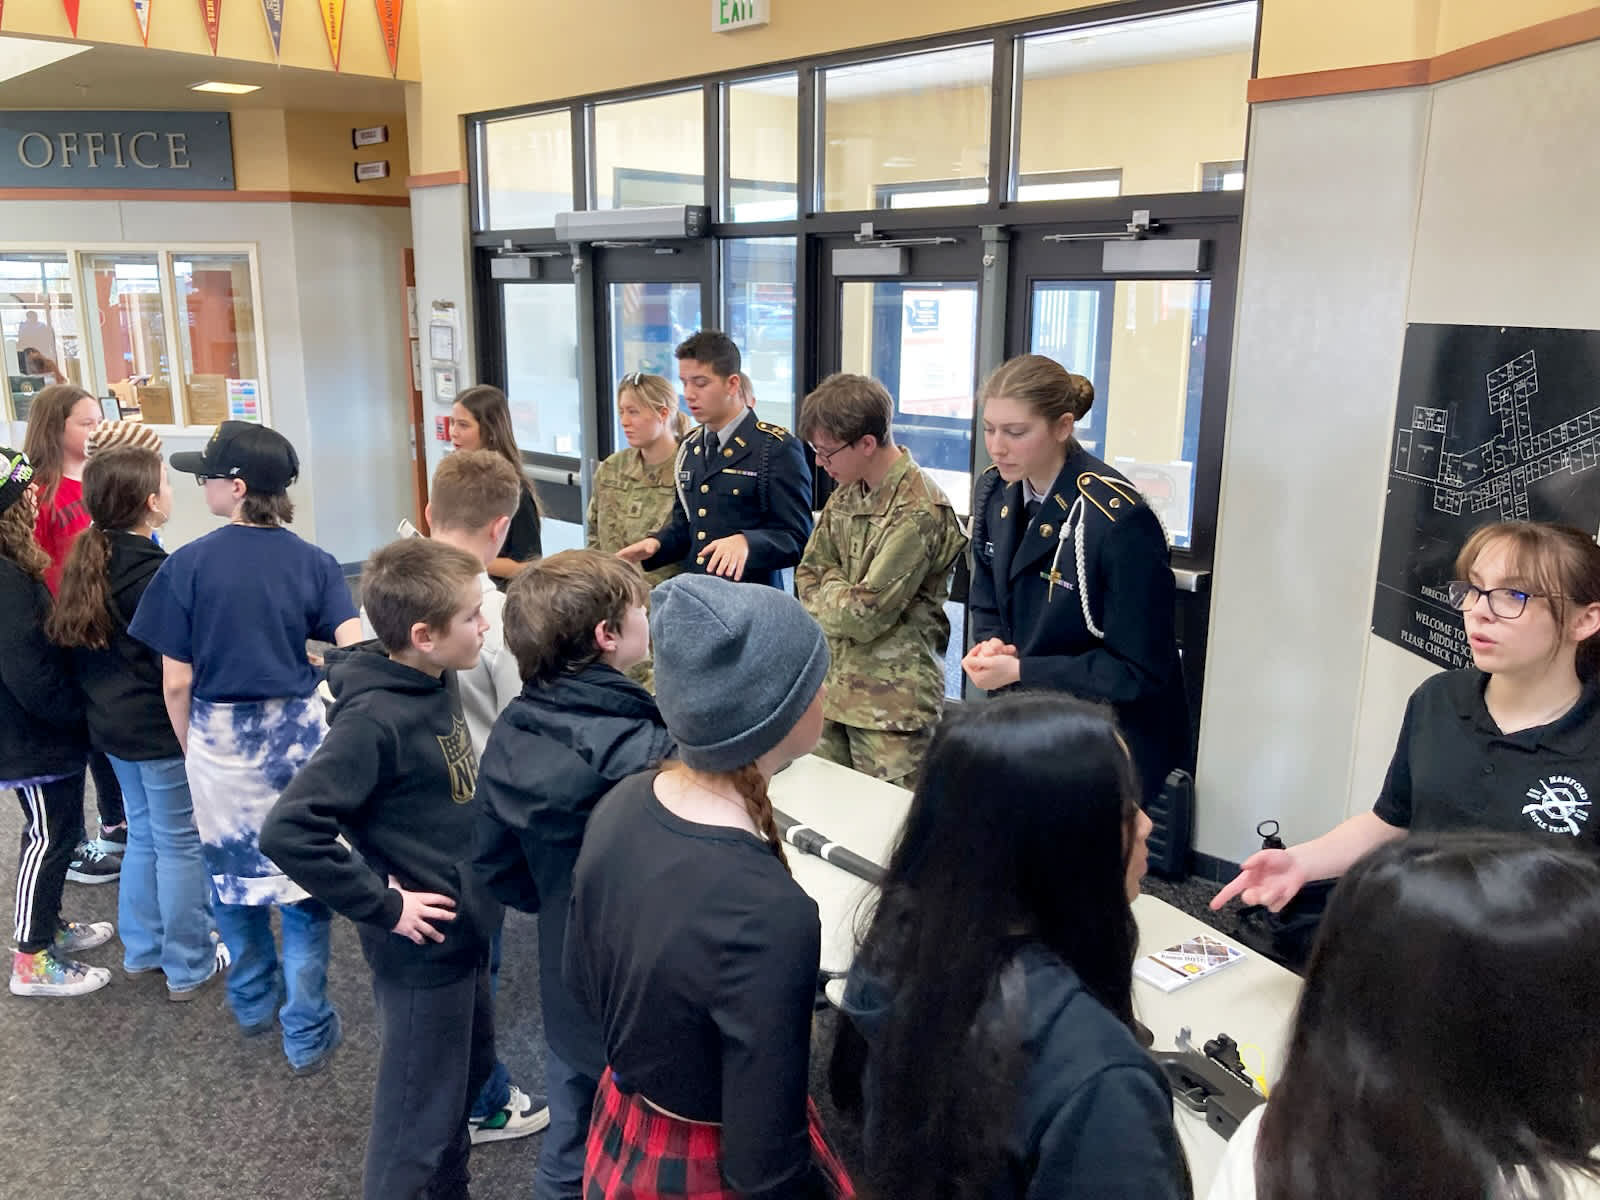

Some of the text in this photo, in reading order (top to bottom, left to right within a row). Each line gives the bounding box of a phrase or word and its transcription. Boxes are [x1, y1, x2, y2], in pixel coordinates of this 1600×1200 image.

[17, 131, 191, 169] OFFICE
[1421, 585, 1450, 604] DIRECTO
[1415, 611, 1465, 641] WELCOME TO
[1400, 630, 1424, 649] PLEASE
[1425, 642, 1451, 662] CHECK
[1452, 654, 1463, 667] IN
[1428, 630, 1459, 653] MIDDLE
[1548, 776, 1589, 800] HANFORD
[1548, 825, 1571, 833] TEAM
